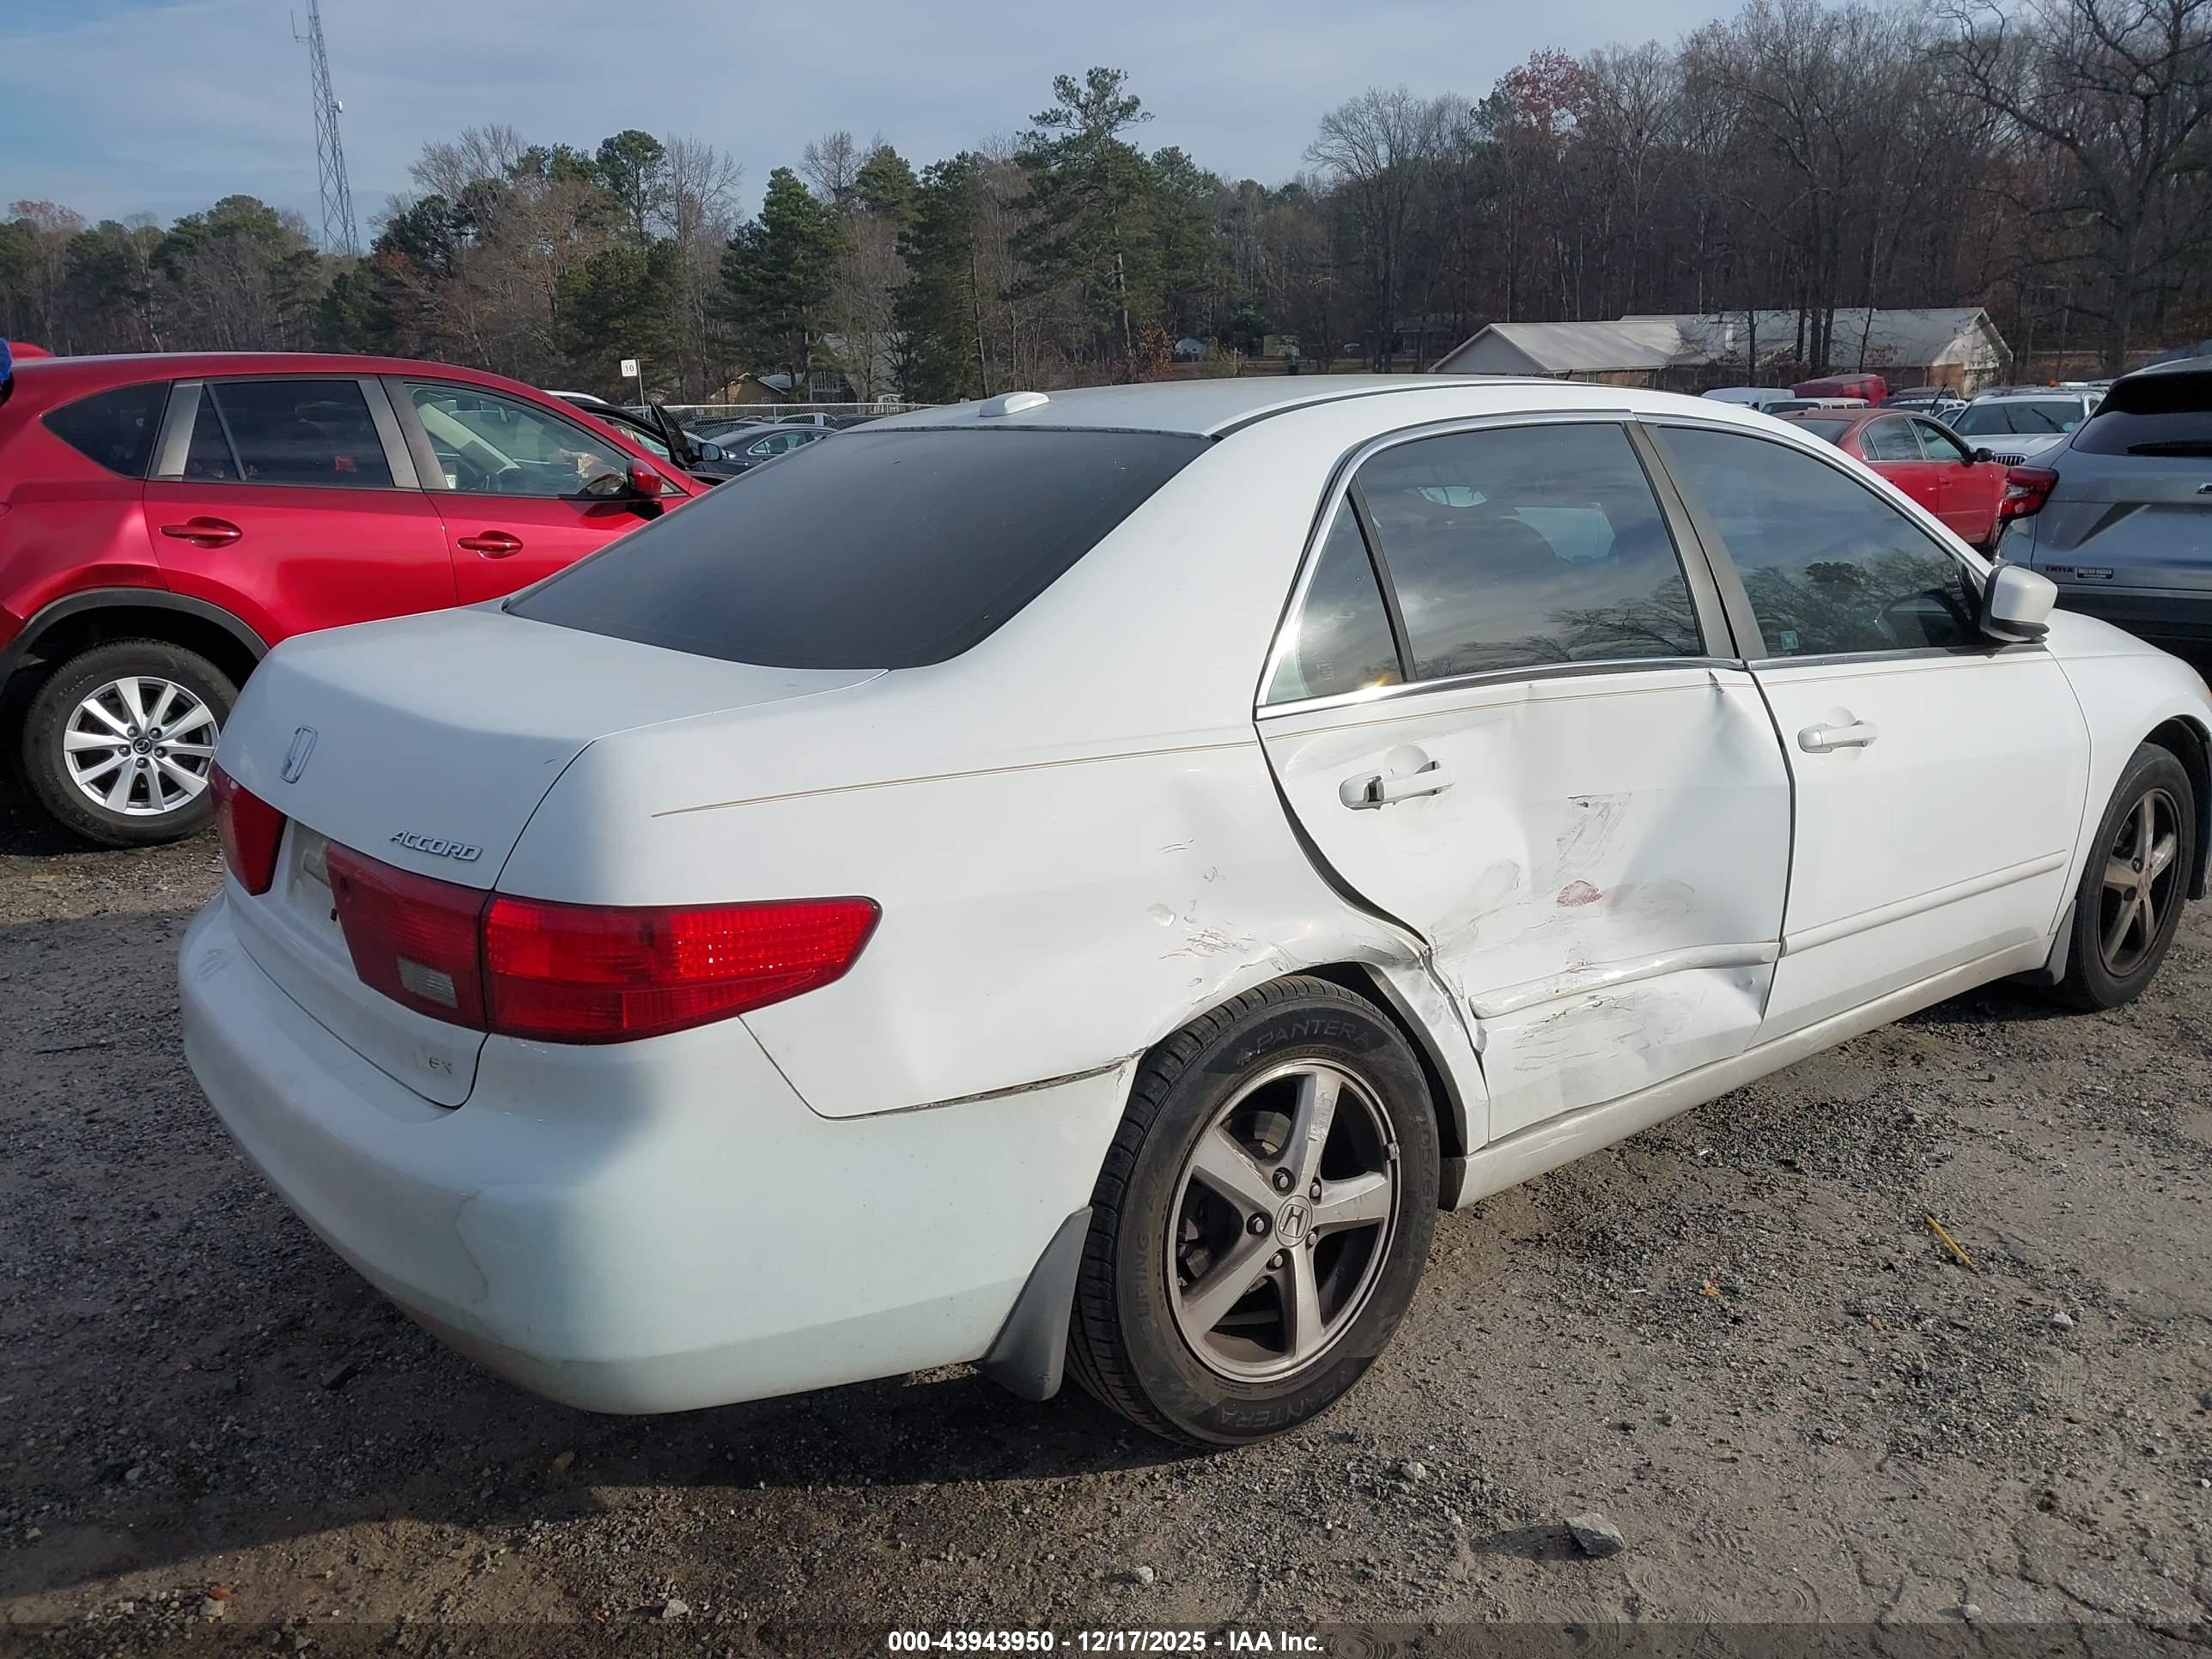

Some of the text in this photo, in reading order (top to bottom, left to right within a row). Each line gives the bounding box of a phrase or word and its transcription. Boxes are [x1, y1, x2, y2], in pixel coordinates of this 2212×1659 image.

[390, 830, 483, 862] ACCORD
[1256, 1018, 1369, 1055] PANTERA
[428, 1057, 452, 1075] EX
